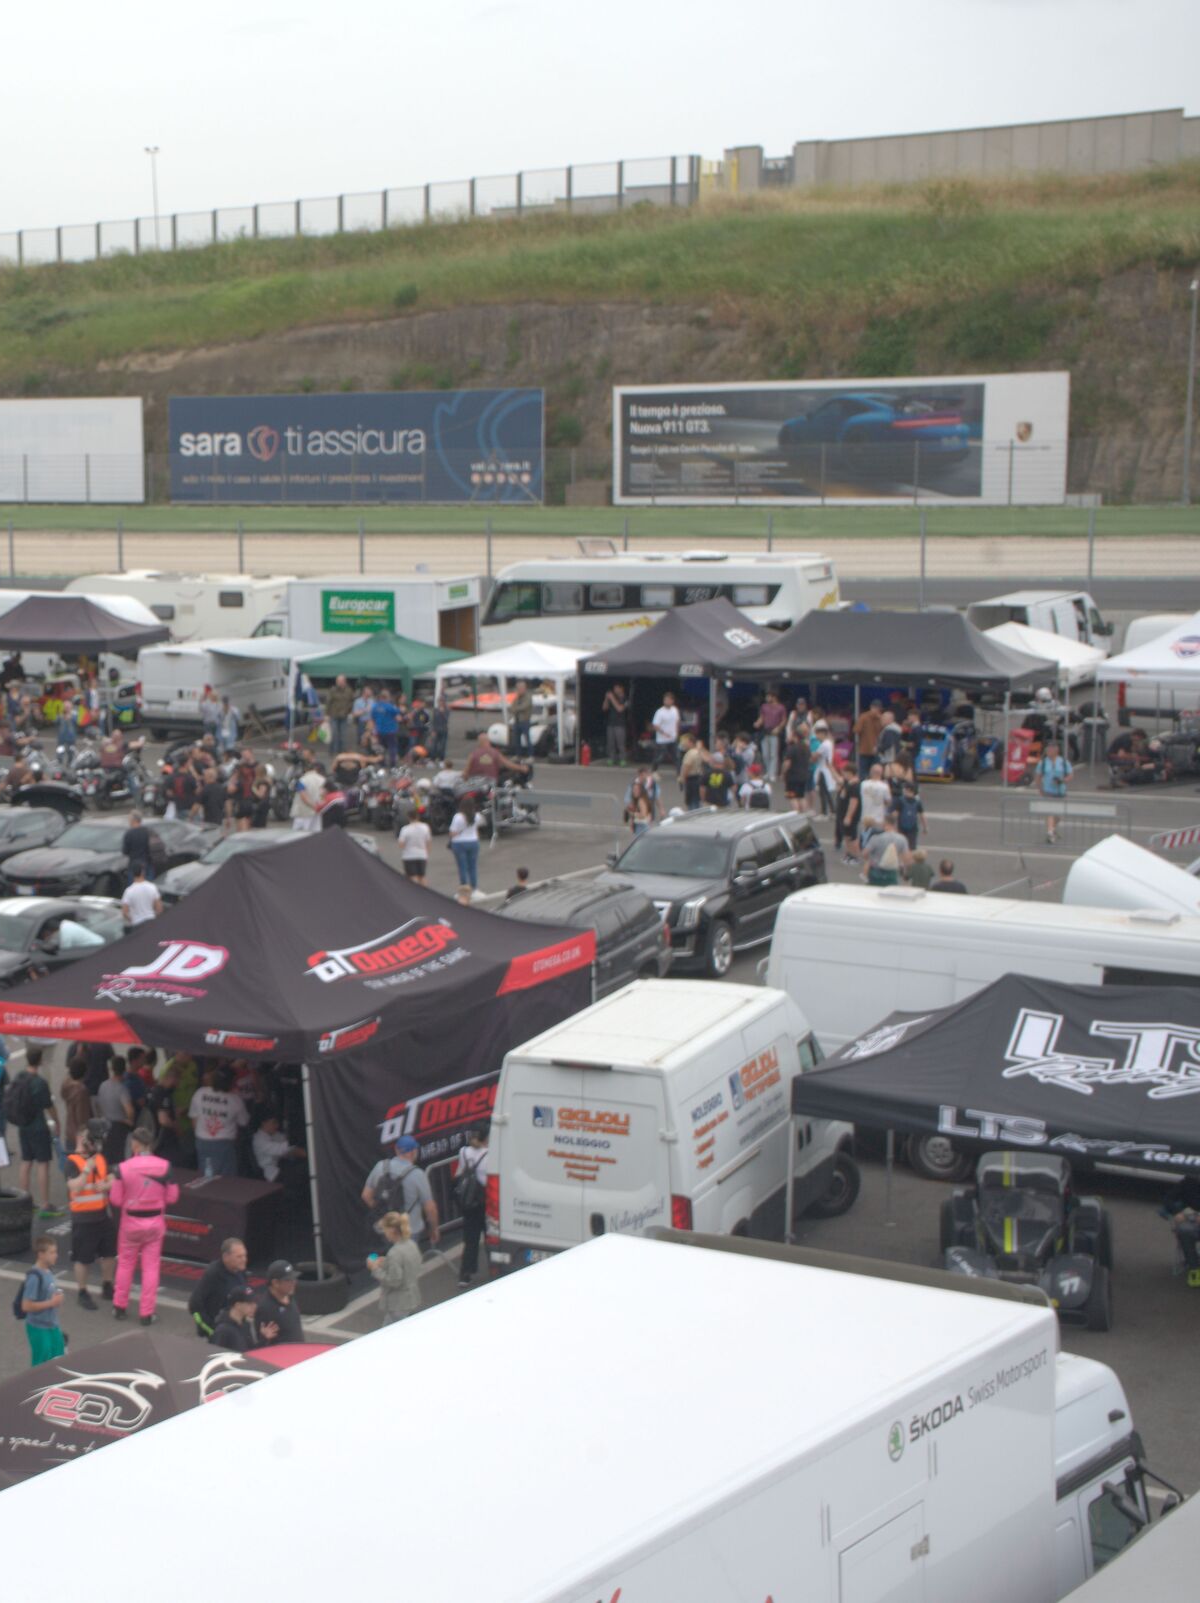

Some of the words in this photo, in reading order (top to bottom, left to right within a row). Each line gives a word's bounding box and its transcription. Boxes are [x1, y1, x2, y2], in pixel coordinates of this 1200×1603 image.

[638, 404, 671, 420] tempo
[630, 421, 662, 434] Nuova
[663, 420, 684, 434] 911
[179, 432, 242, 456] sara
[284, 424, 303, 456] ti
[307, 424, 427, 456] assicura
[328, 596, 389, 612] Europcar
[114, 941, 228, 981] JD
[94, 978, 196, 1006] Racing
[937, 1104, 1048, 1146] LTS
[554, 1135, 611, 1150] NOLEGGIO
[1059, 1276, 1082, 1296] 77
[910, 1394, 965, 1444] ŠKODA
[966, 1378, 997, 1410] Swiss
[996, 1347, 1049, 1393] Motorsport
[8, 1432, 56, 1452] speed
[56, 1441, 78, 1453] we
